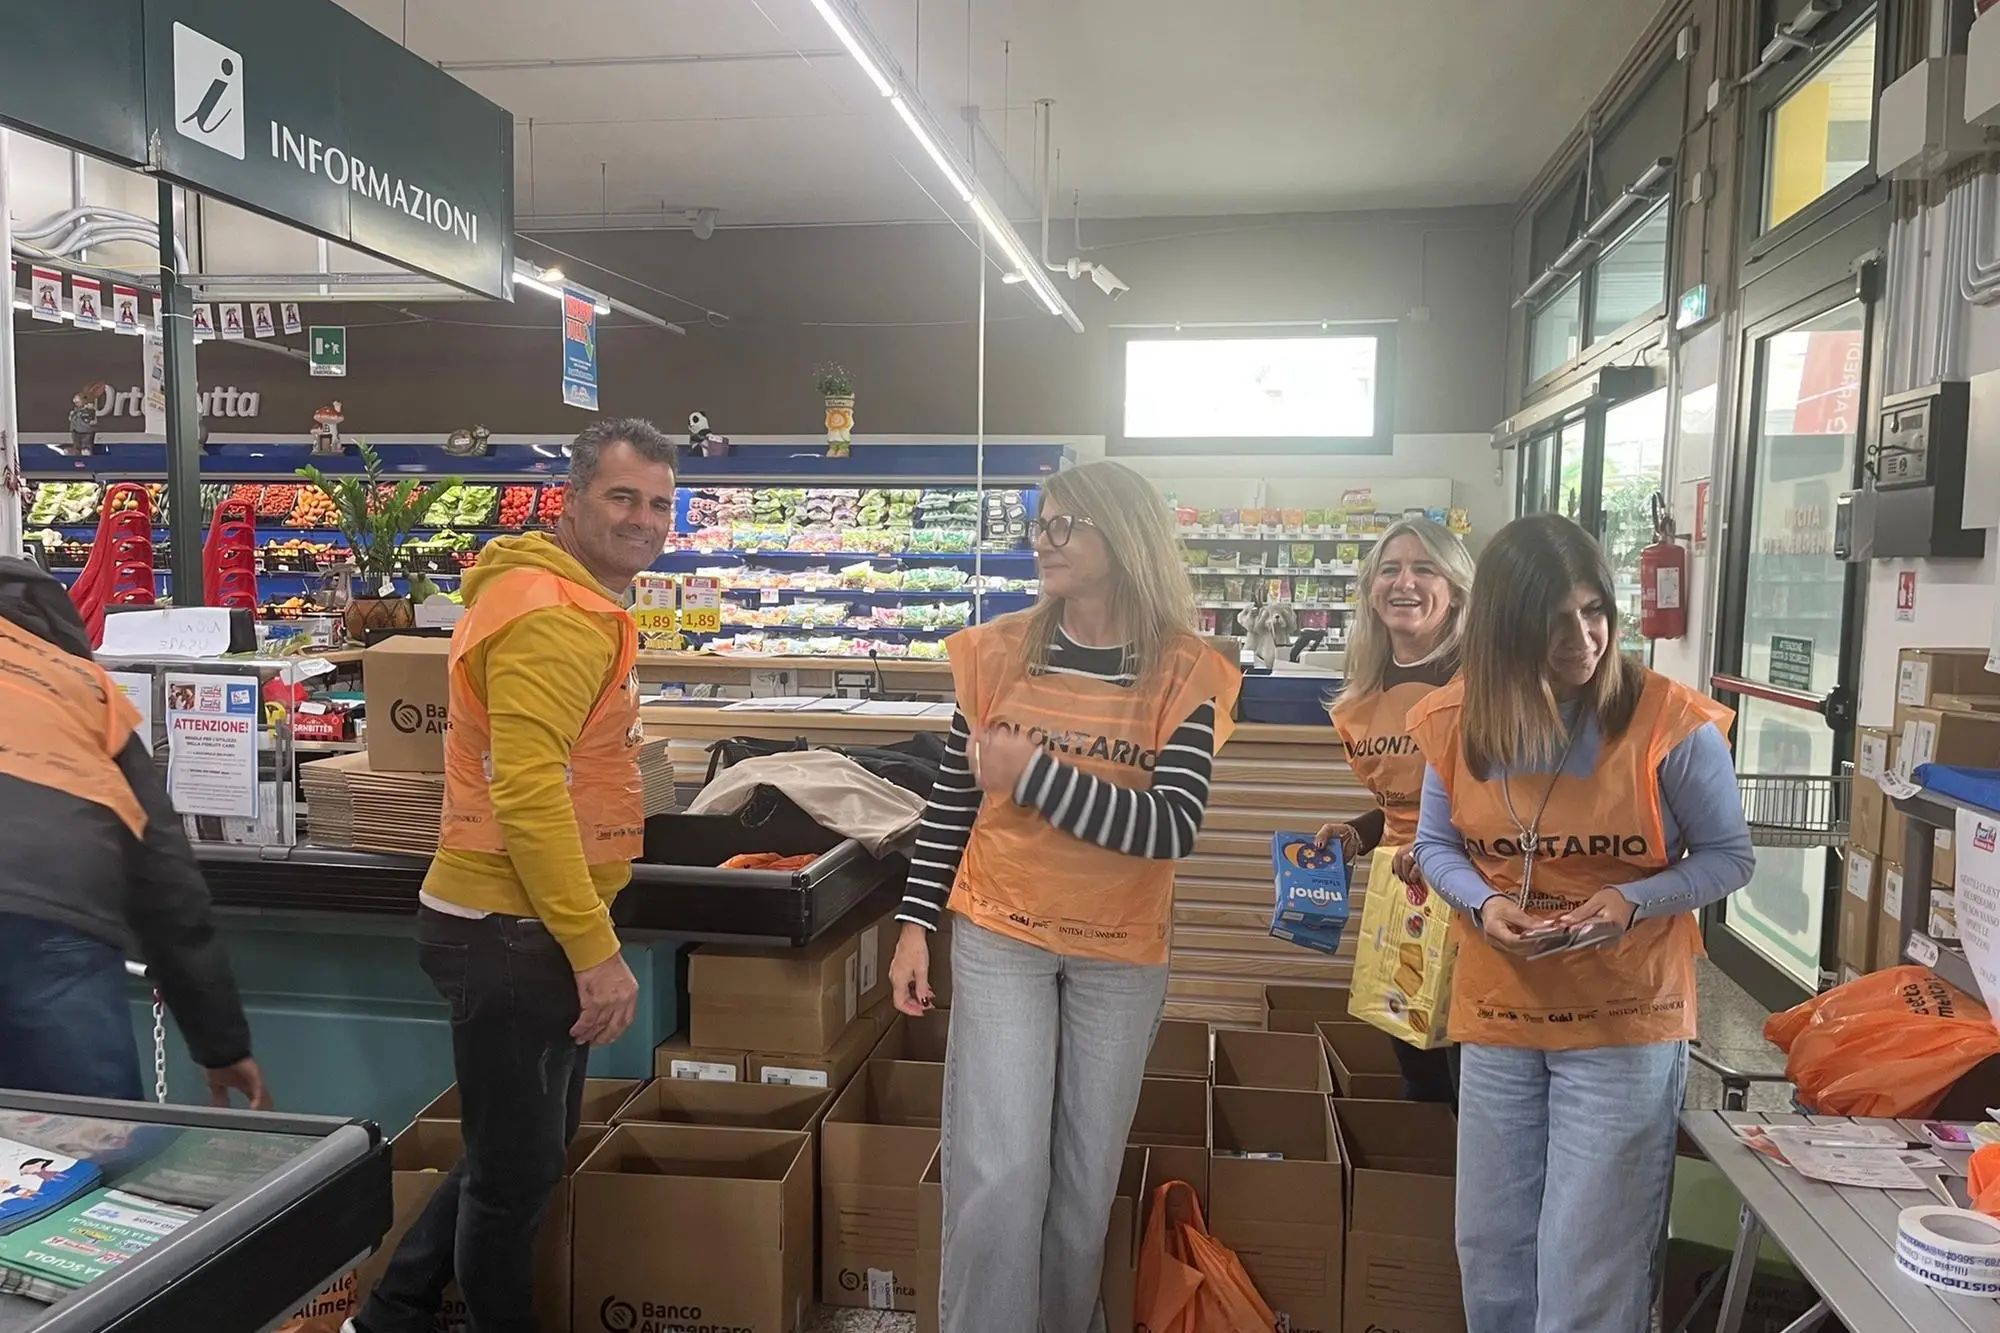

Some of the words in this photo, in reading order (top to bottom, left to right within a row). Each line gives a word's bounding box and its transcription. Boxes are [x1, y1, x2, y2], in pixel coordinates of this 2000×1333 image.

[271, 120, 478, 244] INFORMAZIONI
[640, 614, 671, 628] 1,89
[686, 613, 716, 627] 1,89
[174, 718, 249, 734] ATTENZIONE!
[24, 1250, 84, 1273] SCUOLA
[643, 1302, 701, 1320] Banco
